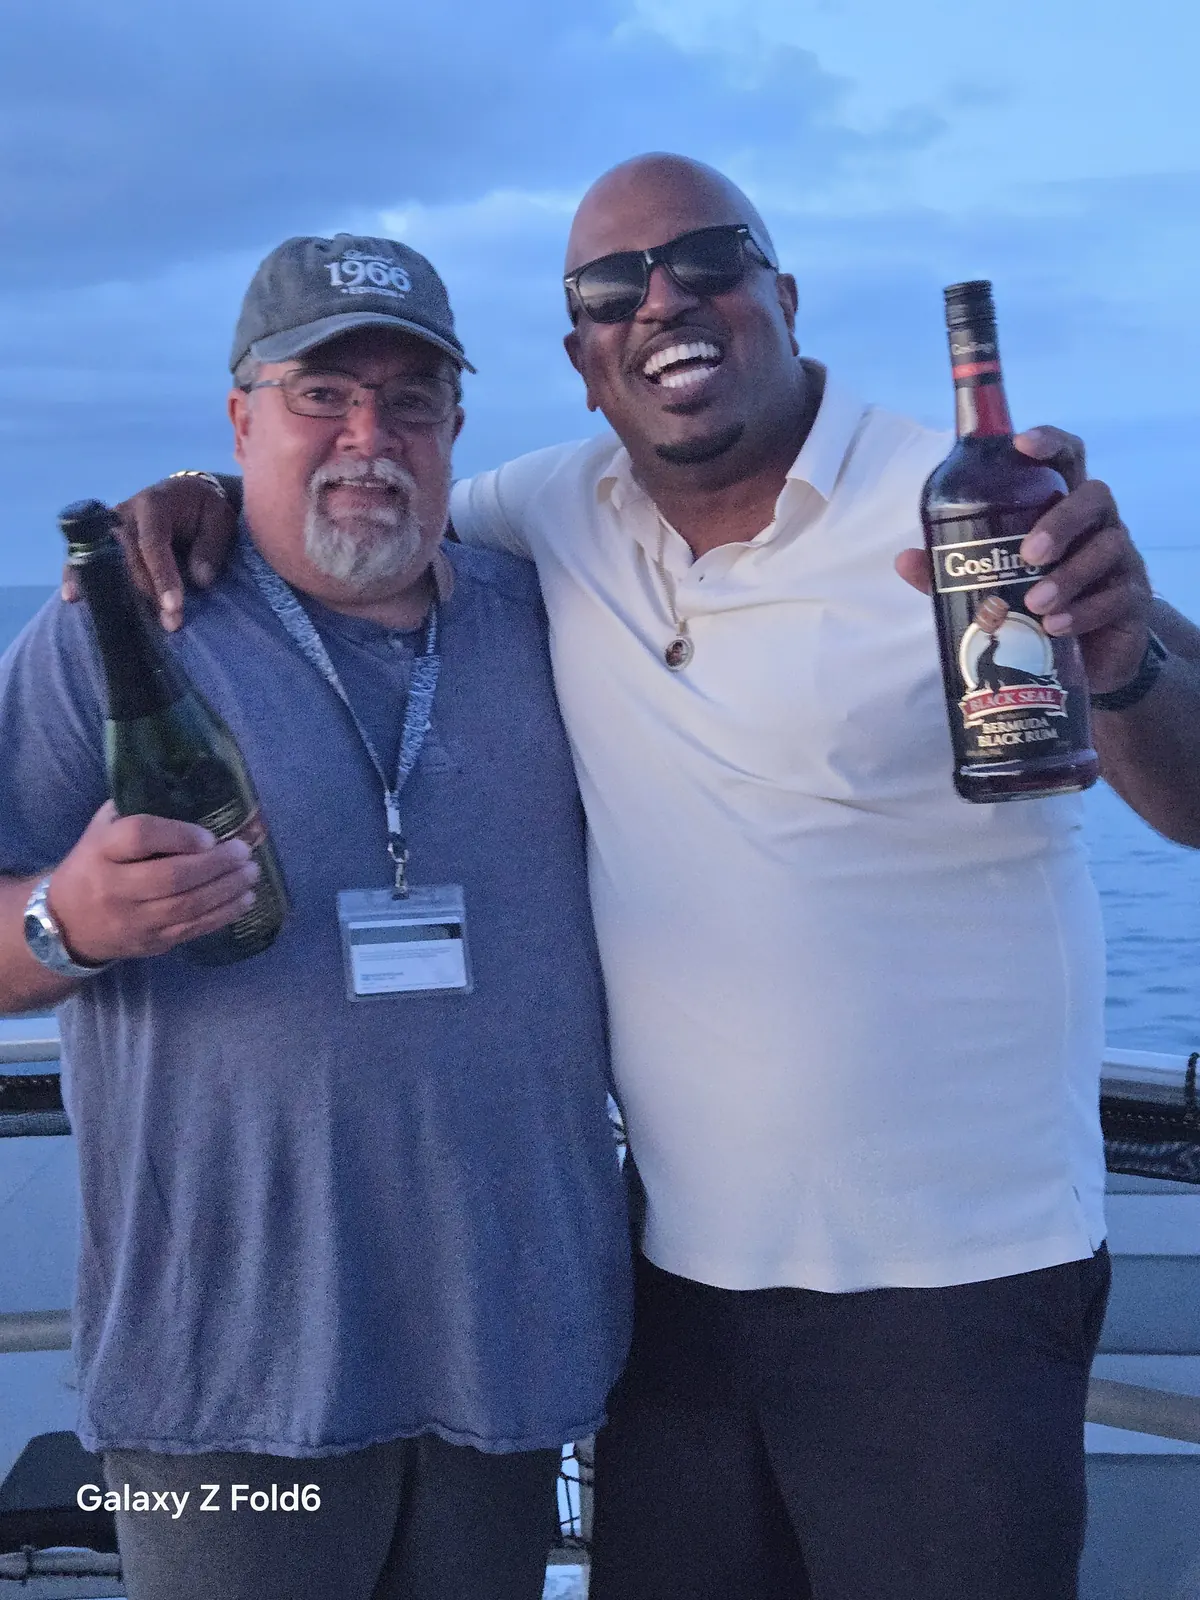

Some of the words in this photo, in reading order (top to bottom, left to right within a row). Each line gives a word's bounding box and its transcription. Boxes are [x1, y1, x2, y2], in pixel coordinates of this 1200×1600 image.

[324, 260, 412, 292] 1966
[944, 547, 1041, 577] Goslin
[970, 692, 1017, 712] BLACK
[1018, 690, 1056, 703] SEAL
[982, 717, 1050, 734] BERMUDA
[977, 732, 1024, 748] BLACK
[1024, 728, 1059, 743] RUM
